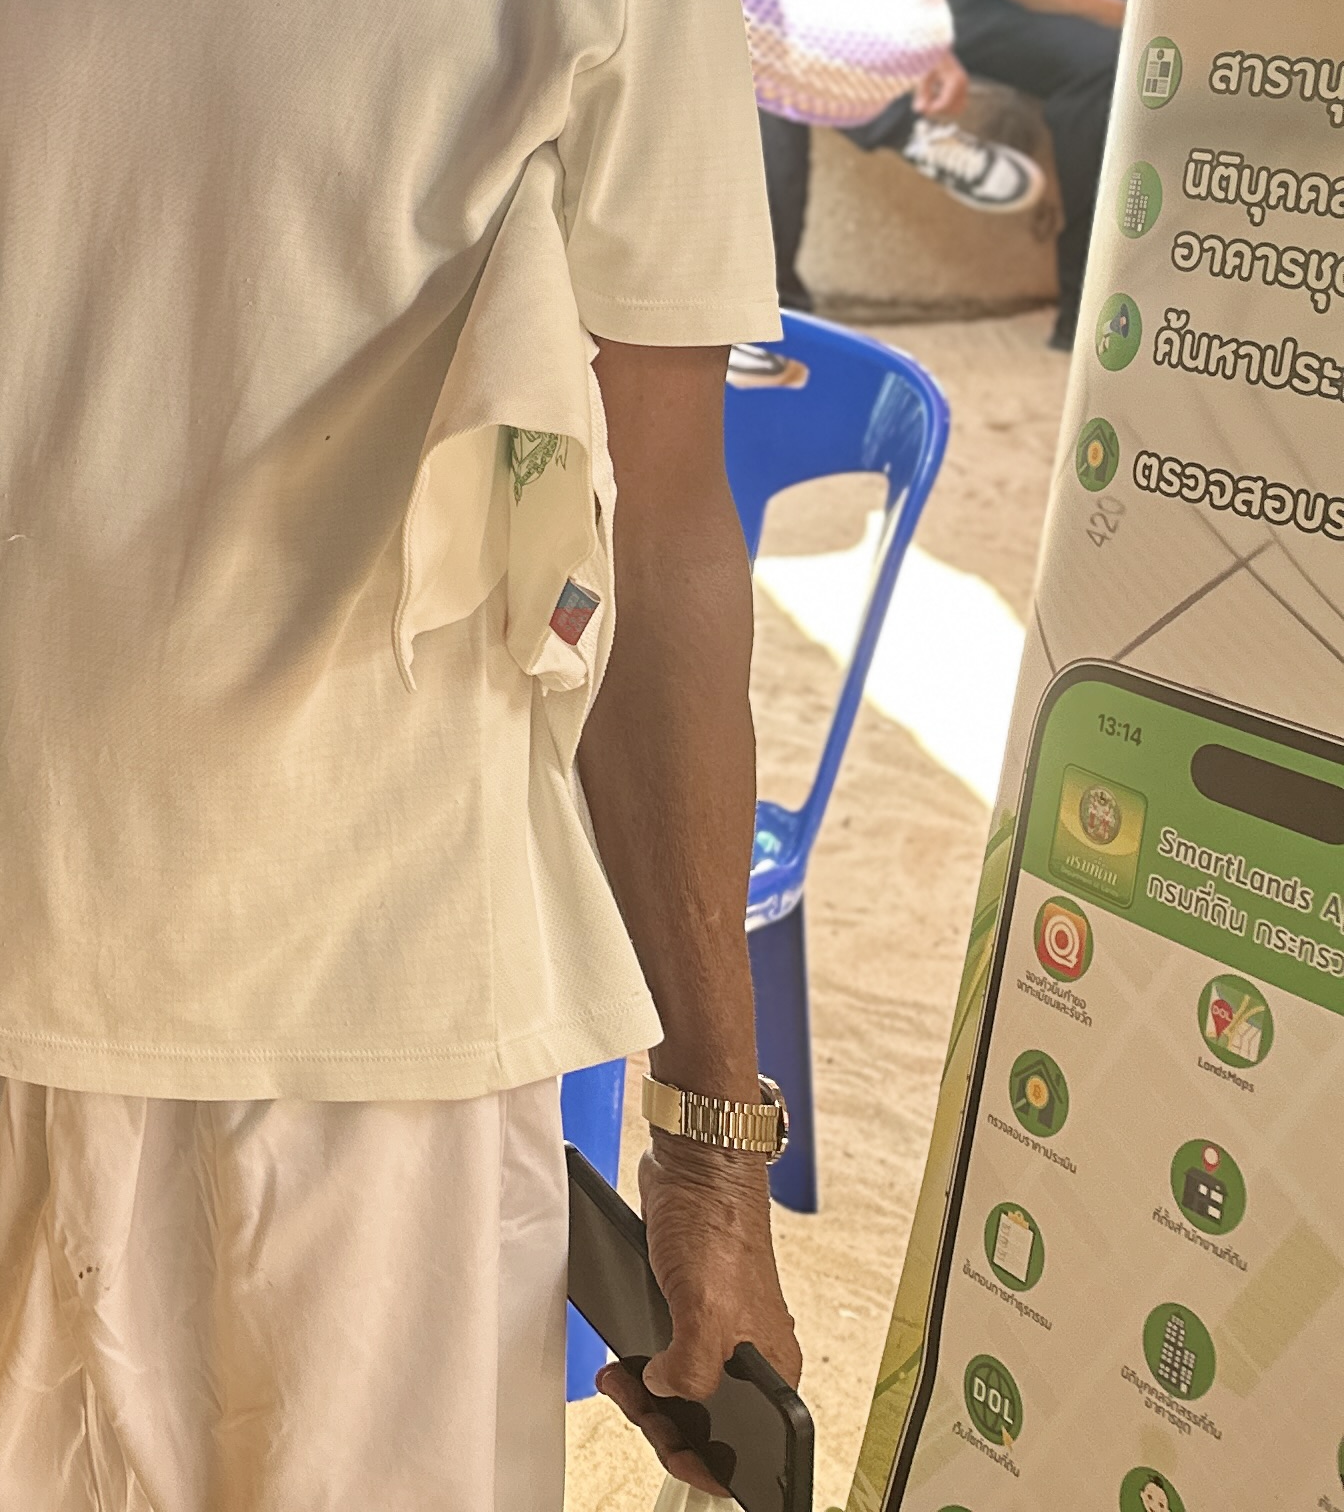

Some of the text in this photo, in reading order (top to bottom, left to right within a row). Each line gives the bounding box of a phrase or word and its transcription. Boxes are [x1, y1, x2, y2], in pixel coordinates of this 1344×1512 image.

[1153, 309, 1344, 401] ค้นหาประ
[1086, 495, 1127, 550] 420
[1096, 712, 1144, 747] 13:14
[1147, 874, 1249, 935] กรมที่ดิน
[1157, 827, 1313, 912] SmartLands
[1321, 889, 1344, 933] A
[1197, 1056, 1255, 1093] LandsMaps
[972, 1376, 1014, 1426] DOL
